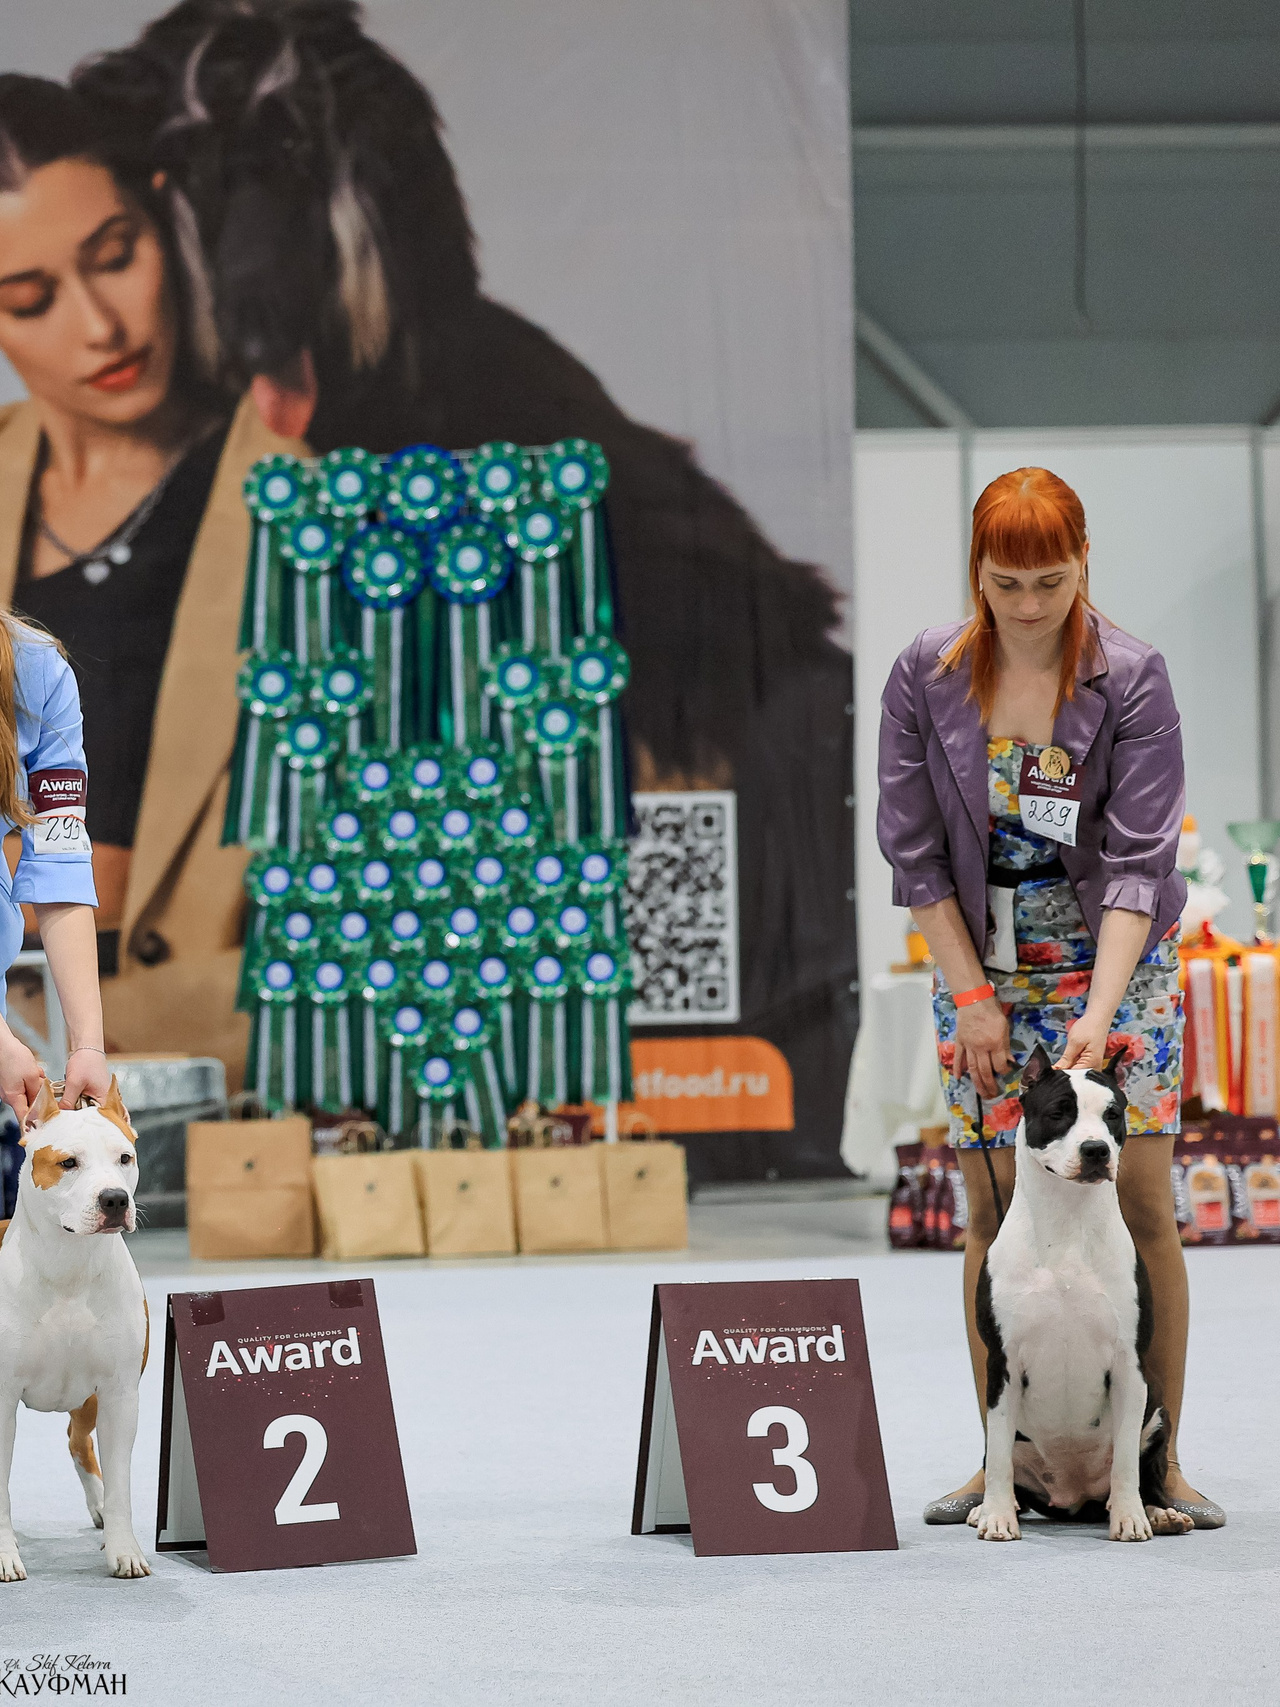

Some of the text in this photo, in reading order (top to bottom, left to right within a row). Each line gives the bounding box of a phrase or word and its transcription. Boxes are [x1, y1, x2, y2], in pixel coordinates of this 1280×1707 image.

[39, 778, 83, 792] Award
[1027, 766, 1076, 786] Awrd
[1028, 800, 1071, 826] 289
[632, 1066, 769, 1099] tfood.ru
[206, 1327, 362, 1377] Award
[237, 1335, 272, 1344] QUALITY
[294, 1329, 342, 1339] CHAMPIONS
[691, 1325, 845, 1365] Award
[263, 1414, 340, 1525] 2
[747, 1405, 819, 1513] 3
